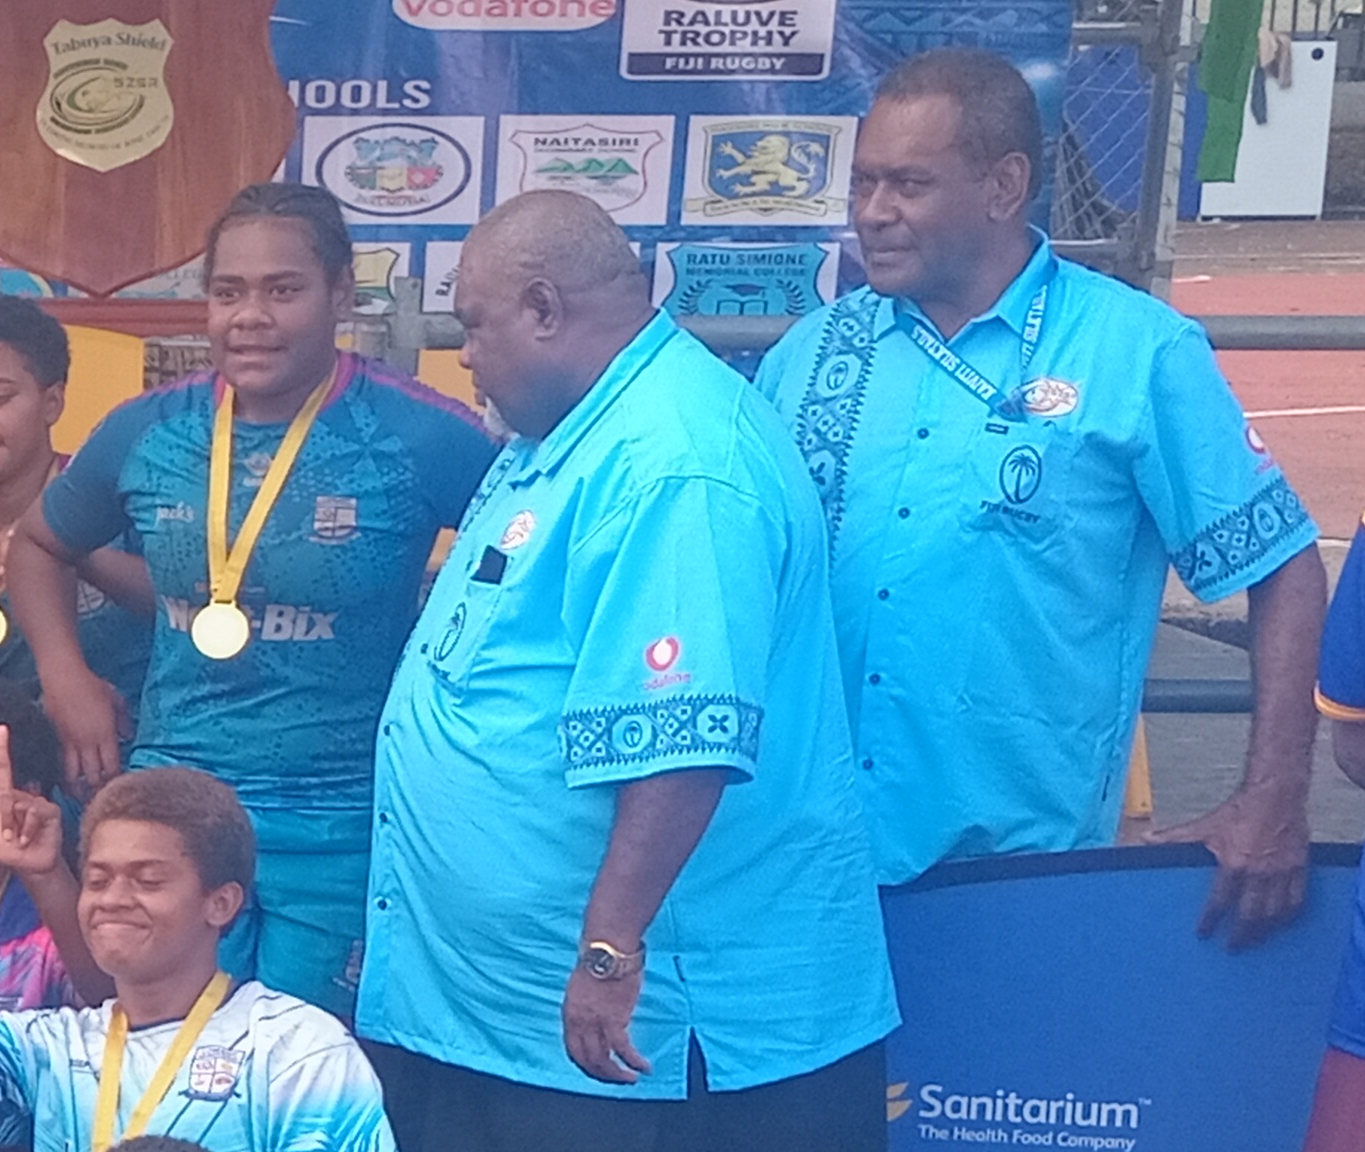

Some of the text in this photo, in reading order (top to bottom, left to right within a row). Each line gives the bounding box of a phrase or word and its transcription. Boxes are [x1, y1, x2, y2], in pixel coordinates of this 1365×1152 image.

[662, 10, 799, 28] RALUVE
[116, 32, 168, 51] Shield
[658, 29, 800, 48] TROPHY
[664, 56, 788, 72] FIJI RUGBY
[533, 136, 641, 147] NAITASIRI
[685, 252, 808, 267] RATU SIMIONE
[918, 1083, 1139, 1129] Sanitarium
[917, 1124, 1136, 1152] The Health Food Company
